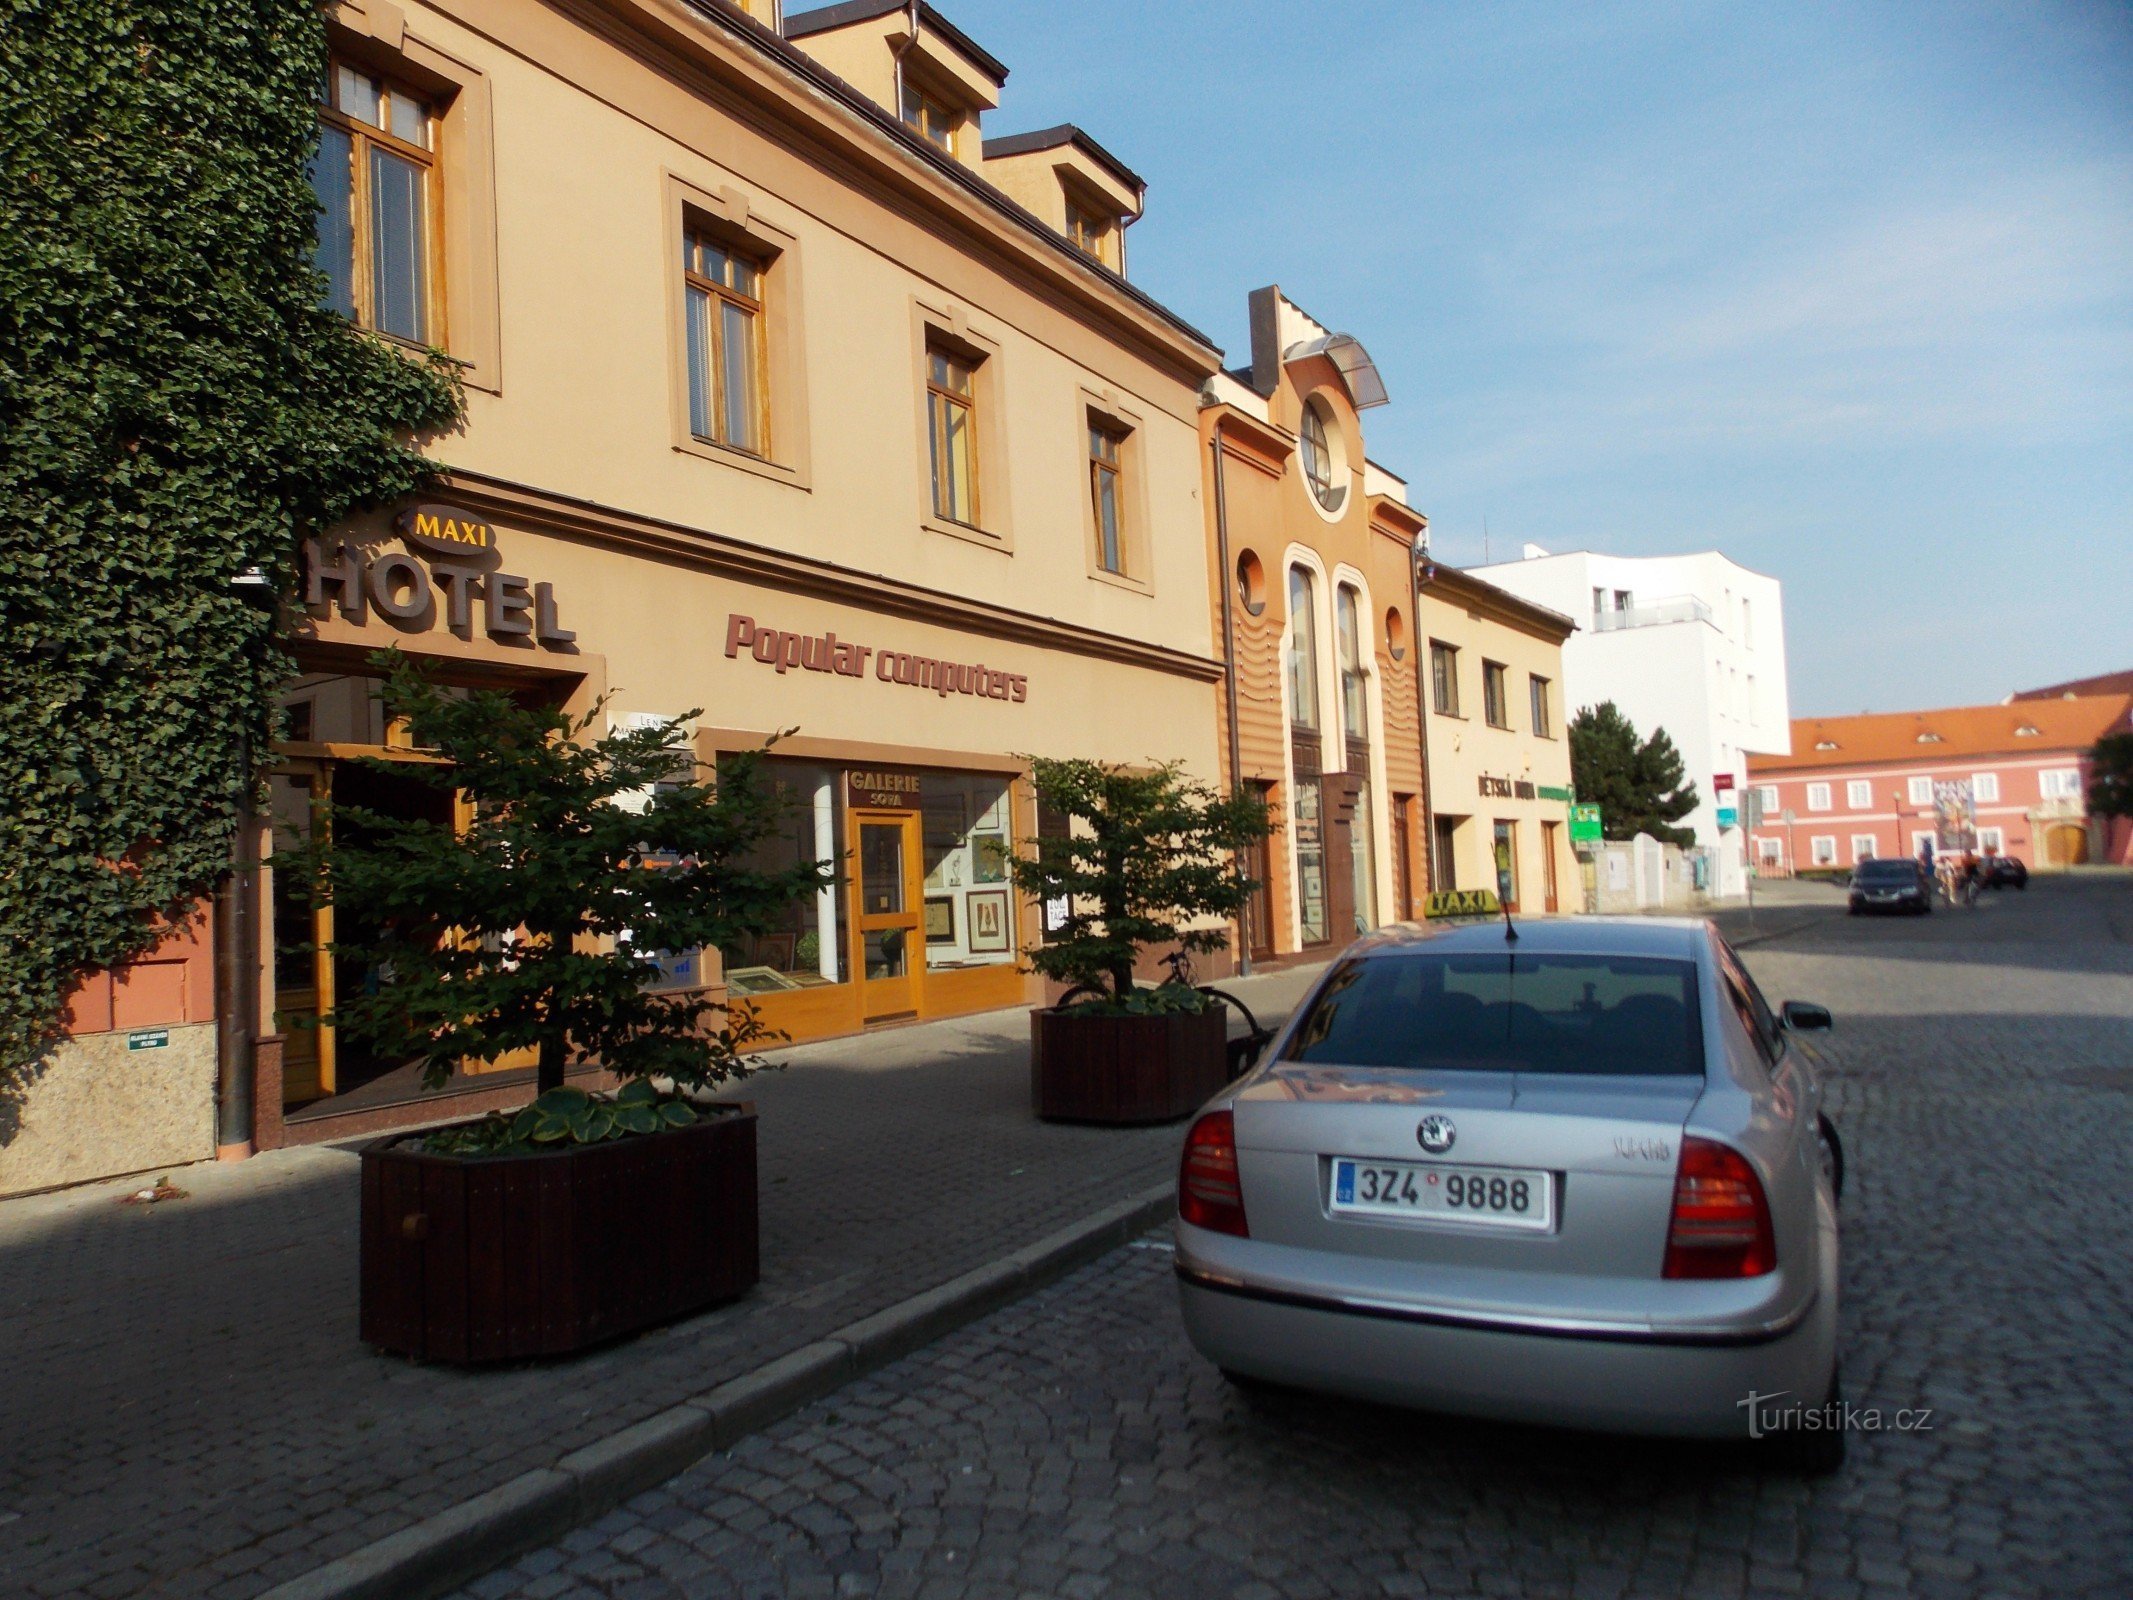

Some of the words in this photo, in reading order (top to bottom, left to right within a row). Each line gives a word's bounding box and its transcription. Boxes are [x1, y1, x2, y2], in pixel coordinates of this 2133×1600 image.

[416, 513, 487, 547] MAXI
[305, 538, 577, 643] HOTEL
[725, 613, 872, 674] Popular
[876, 649, 1028, 703] computers
[850, 771, 920, 793] GALERIE
[1432, 890, 1486, 912] TAXI
[1360, 1168, 1419, 1204] 3Z4
[1446, 1173, 1530, 1213] 9888
